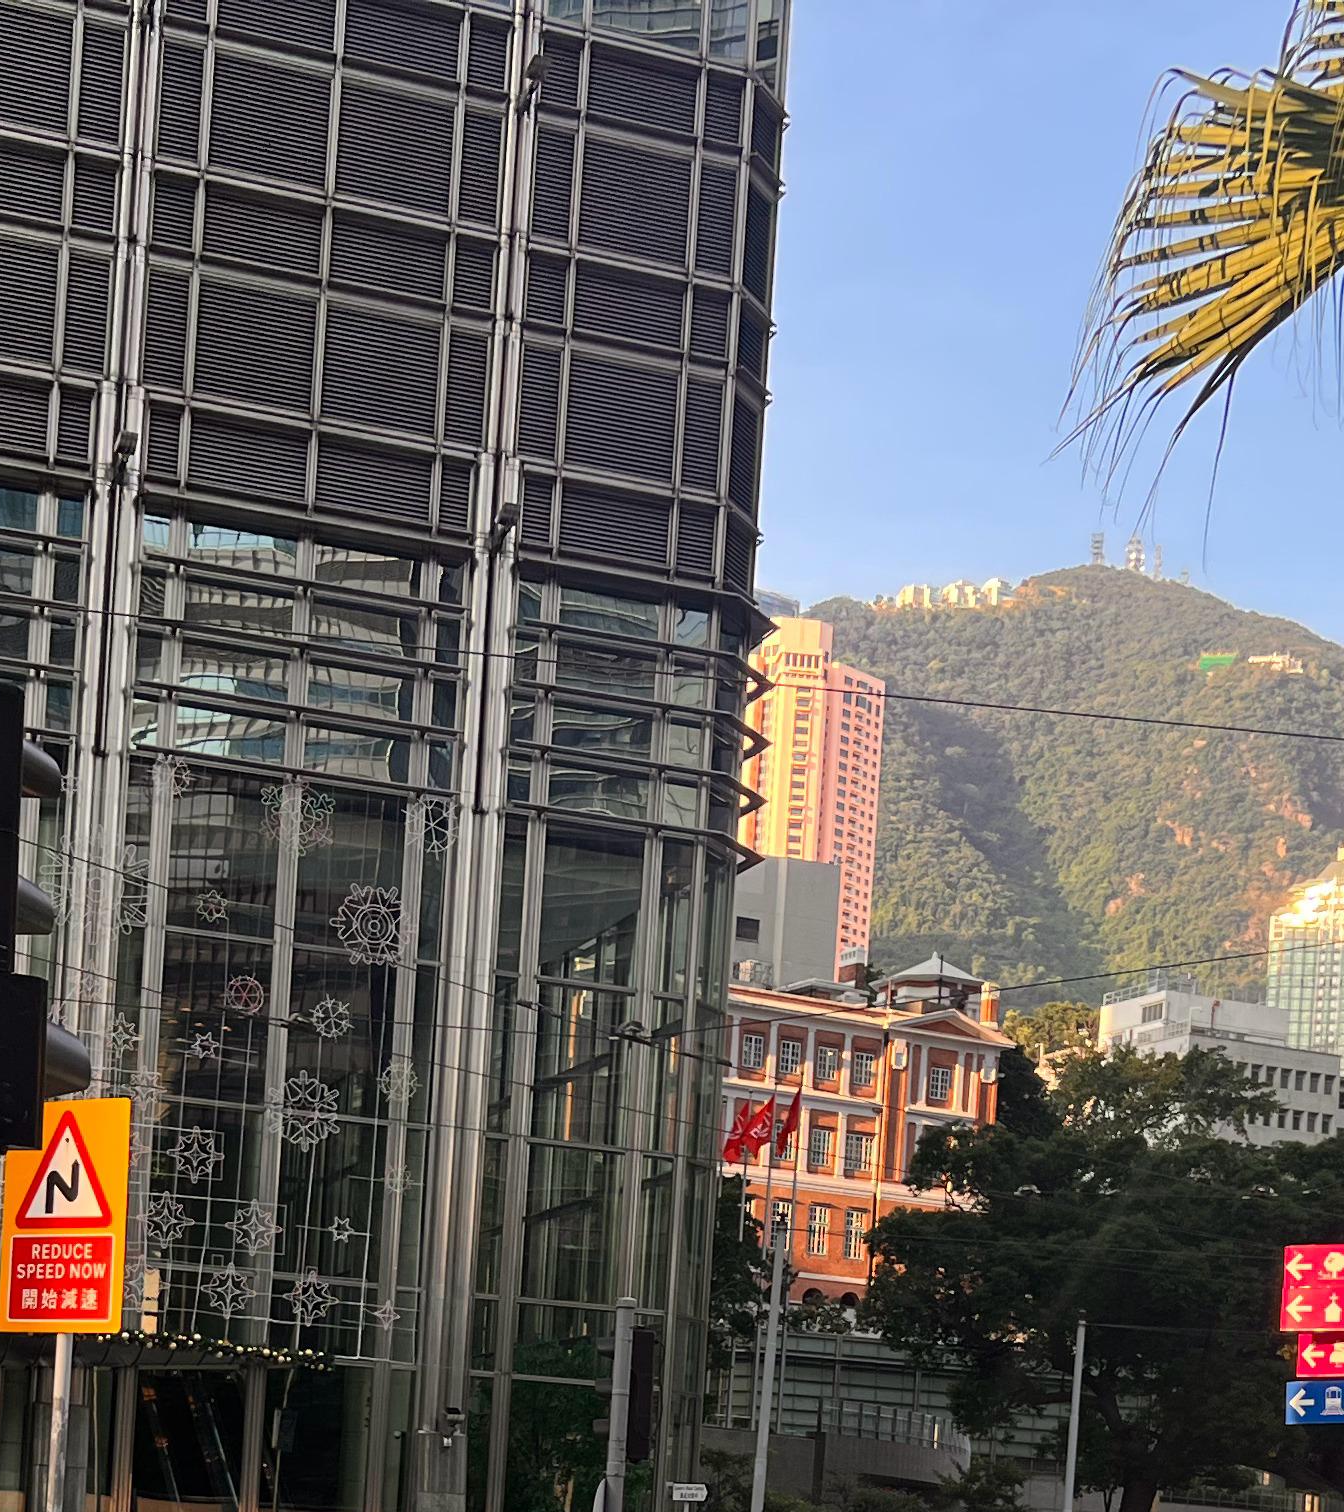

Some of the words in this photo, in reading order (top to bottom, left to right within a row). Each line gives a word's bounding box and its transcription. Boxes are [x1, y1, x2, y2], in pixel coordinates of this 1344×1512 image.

[31, 1243, 93, 1260] REDUCE
[16, 1263, 66, 1280] SPEED
[69, 1262, 107, 1280] NOW
[21, 1287, 99, 1311] 開始減速
